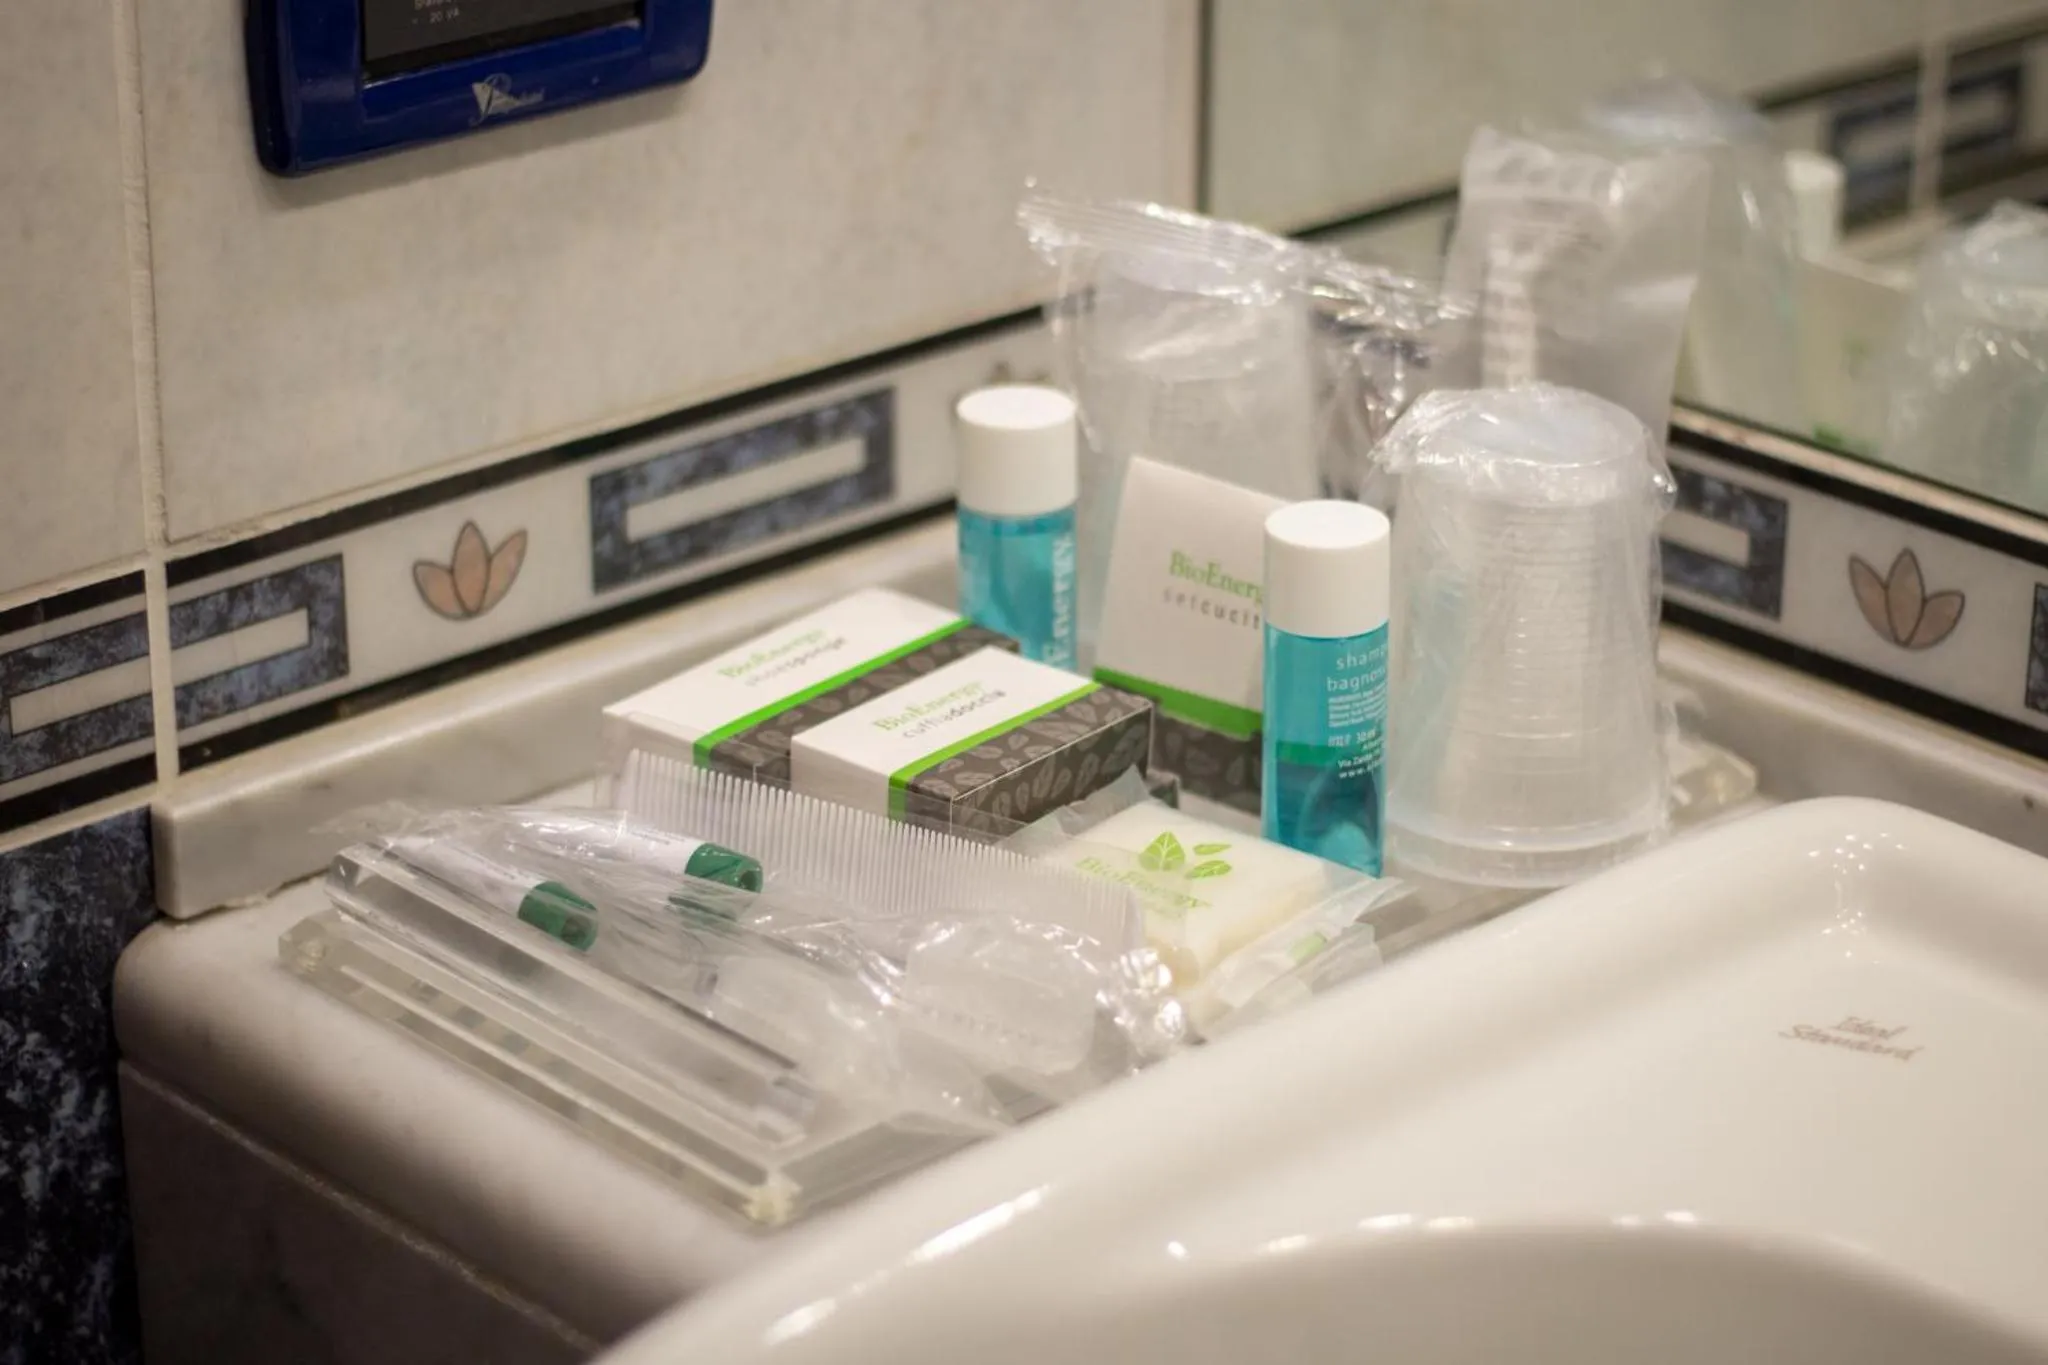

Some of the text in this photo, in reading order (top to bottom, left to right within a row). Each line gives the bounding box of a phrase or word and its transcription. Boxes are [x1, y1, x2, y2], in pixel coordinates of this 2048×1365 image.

[1041, 533, 1076, 665] Energy
[1169, 549, 1263, 608] BioEnerg
[1163, 586, 1260, 631] setcucit
[1327, 664, 1386, 692] bagnos
[1336, 642, 1388, 671] shamp
[872, 680, 986, 732] BioEnergy
